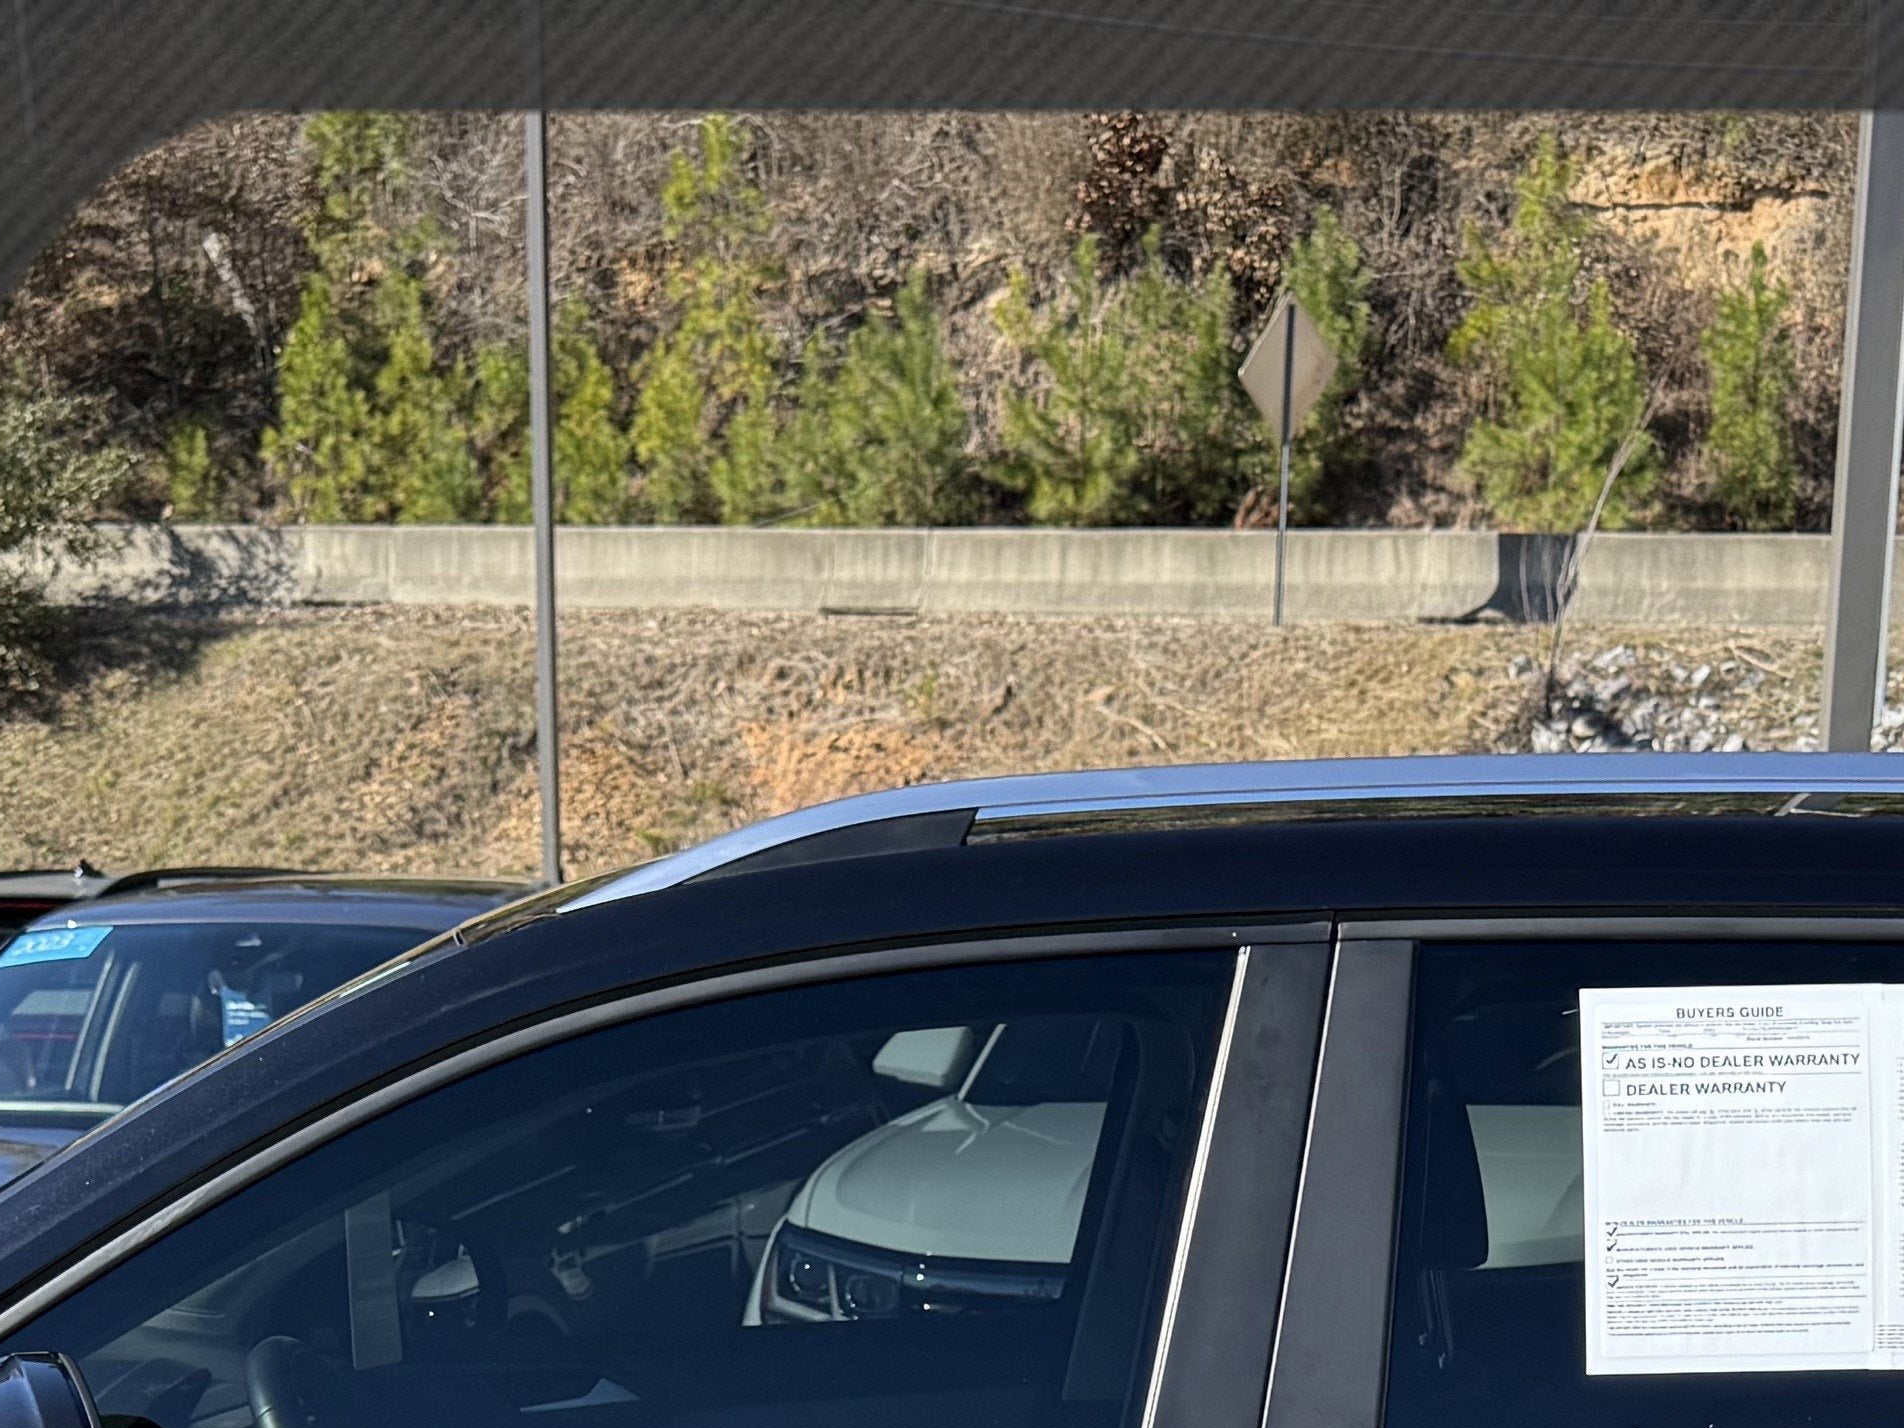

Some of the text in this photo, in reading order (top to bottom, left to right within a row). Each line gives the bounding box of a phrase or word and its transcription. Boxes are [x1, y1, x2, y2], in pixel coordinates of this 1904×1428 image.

[1676, 1006, 1784, 1019] BUYERS GUIDE
[1625, 1057, 1647, 1070] AS
[1700, 1055, 1764, 1069] DEALER
[1768, 1052, 1861, 1068] WARRANTY
[1626, 1081, 1787, 1097] DEALER WARRANTY
